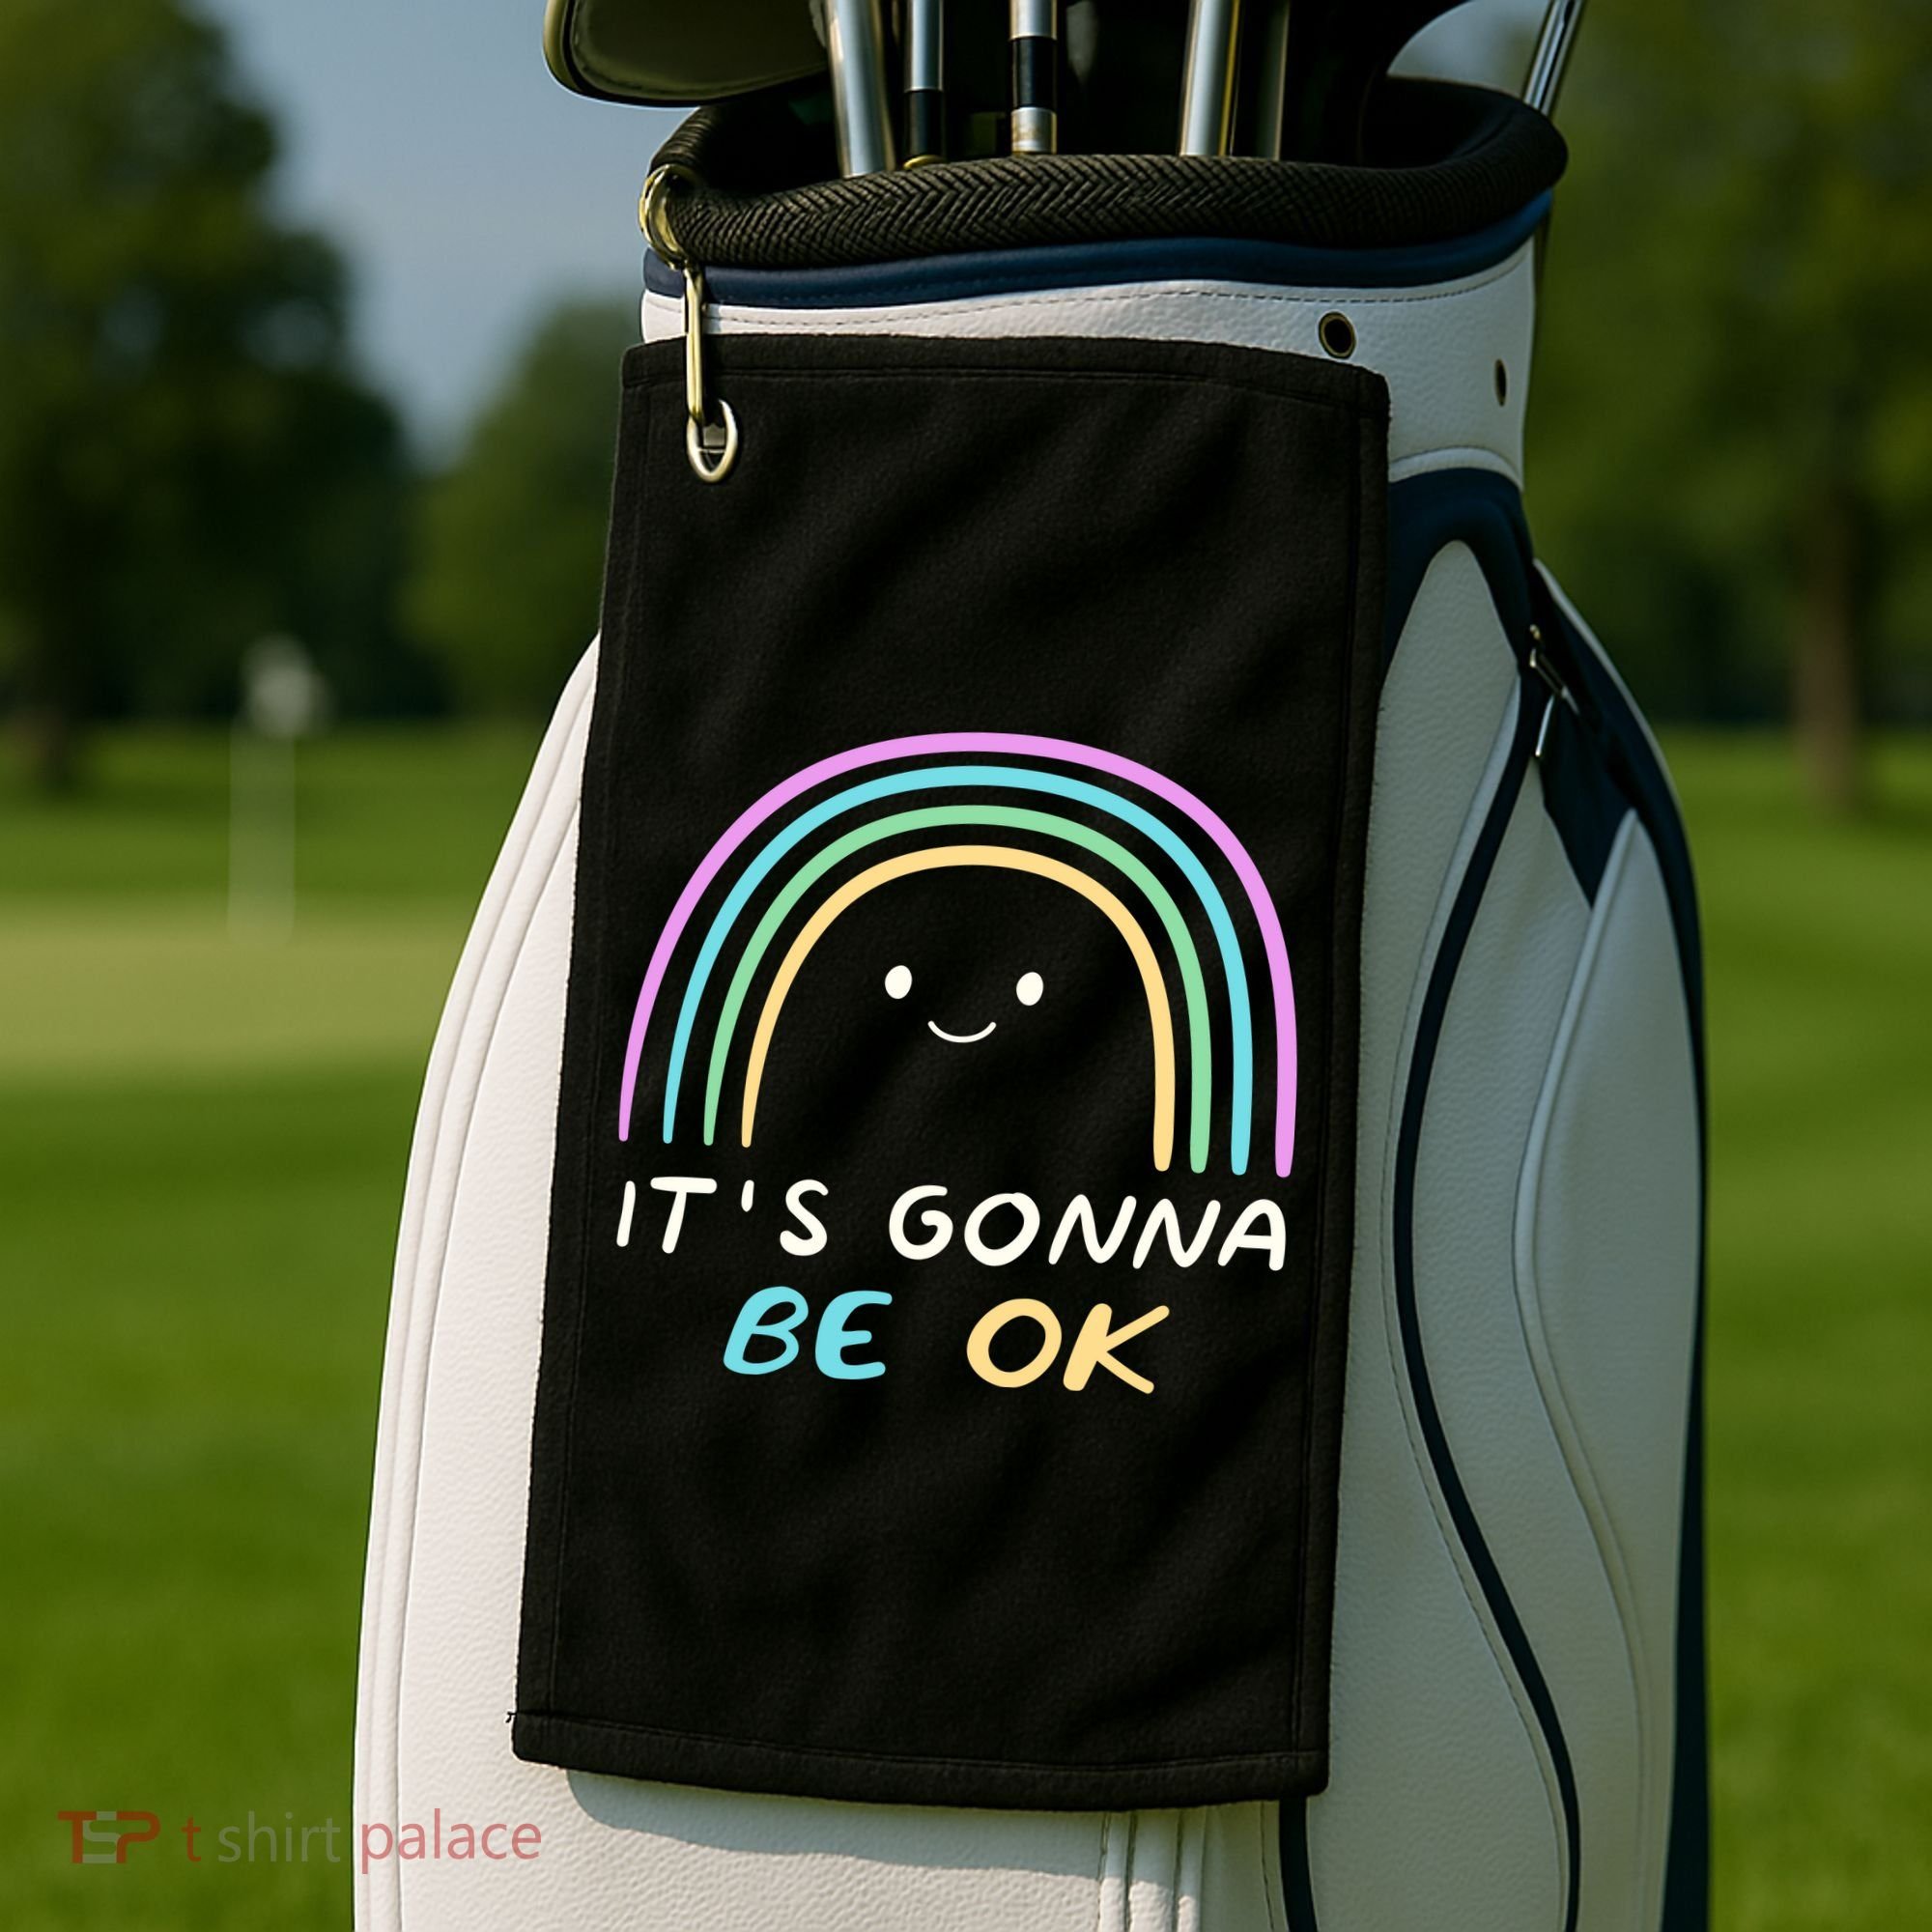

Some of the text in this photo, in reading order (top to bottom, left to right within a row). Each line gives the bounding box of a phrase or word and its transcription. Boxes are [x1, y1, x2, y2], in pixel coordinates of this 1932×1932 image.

[616, 1176, 1287, 1271] IT'S GONNA
[723, 1286, 1170, 1394] BE OK
